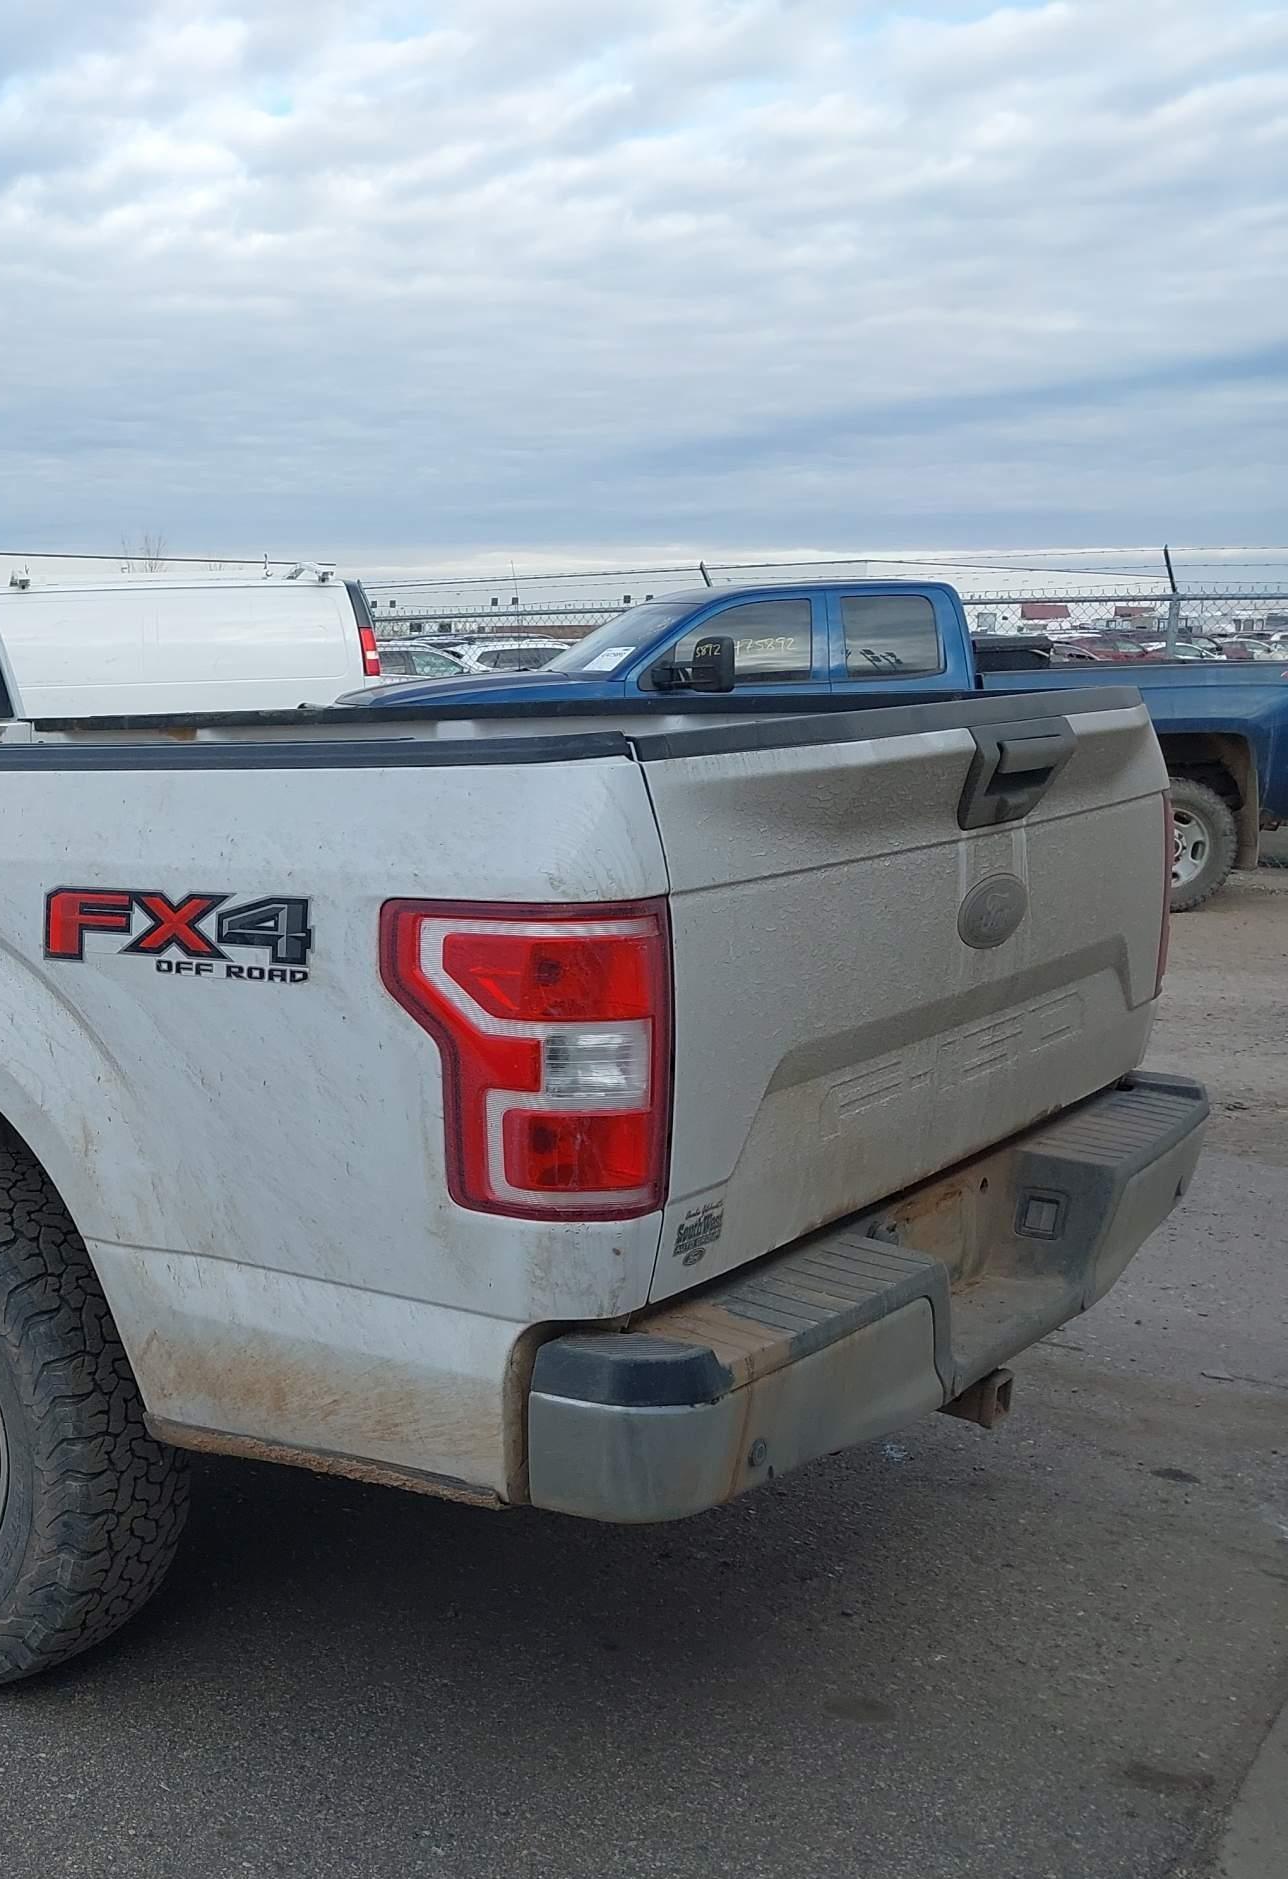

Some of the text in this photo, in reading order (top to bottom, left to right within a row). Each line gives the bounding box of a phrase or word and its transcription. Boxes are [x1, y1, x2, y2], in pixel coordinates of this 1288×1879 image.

[45, 888, 312, 965] FX4
[156, 959, 309, 982] OFF ROAD
